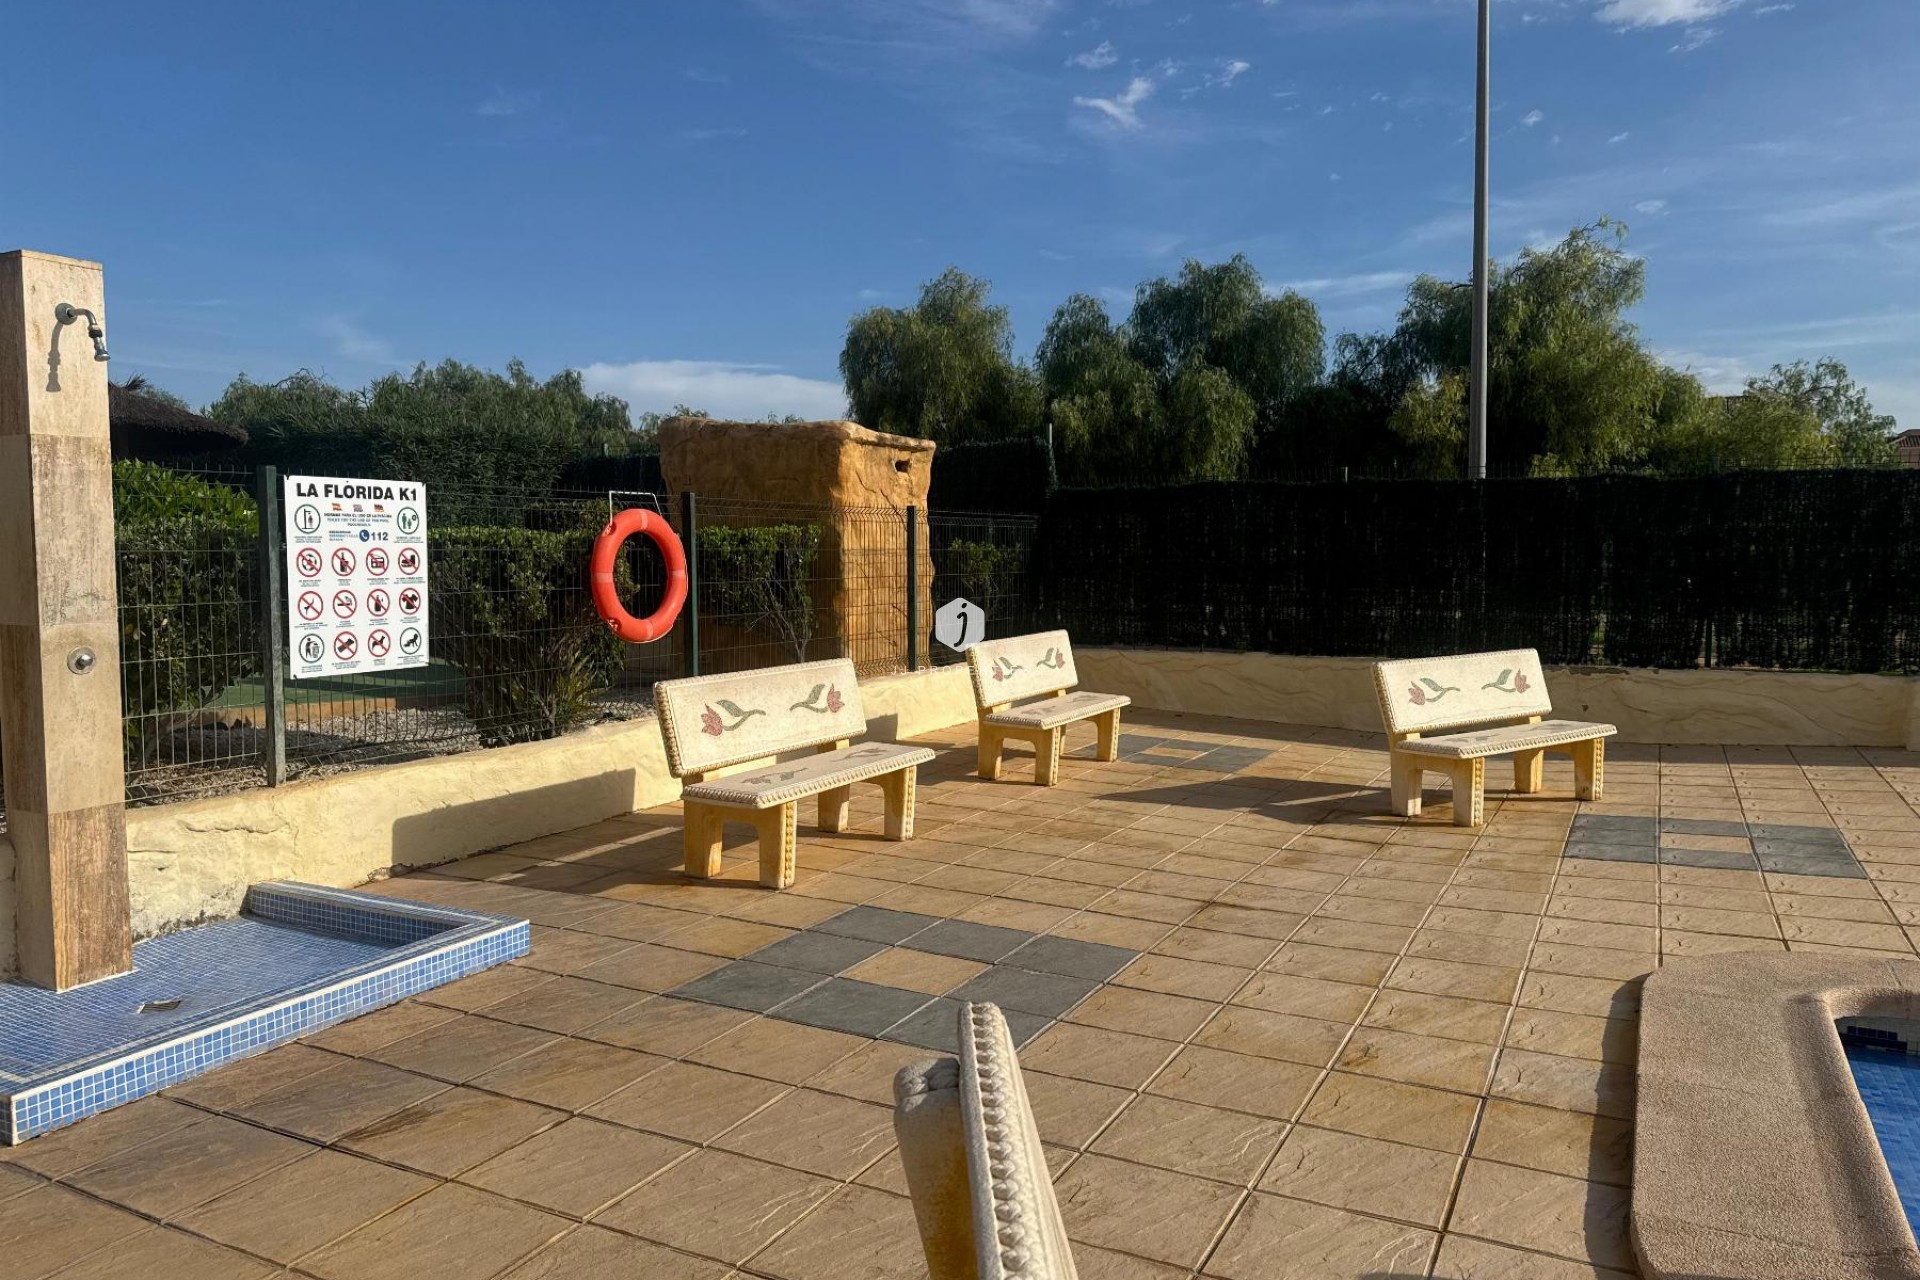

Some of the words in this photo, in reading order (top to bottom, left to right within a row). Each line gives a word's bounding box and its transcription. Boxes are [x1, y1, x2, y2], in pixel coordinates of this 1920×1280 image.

[296, 482, 318, 497] LA
[323, 483, 394, 500] FLORIDA
[399, 487, 417, 501] K1
[371, 531, 389, 541] 112
